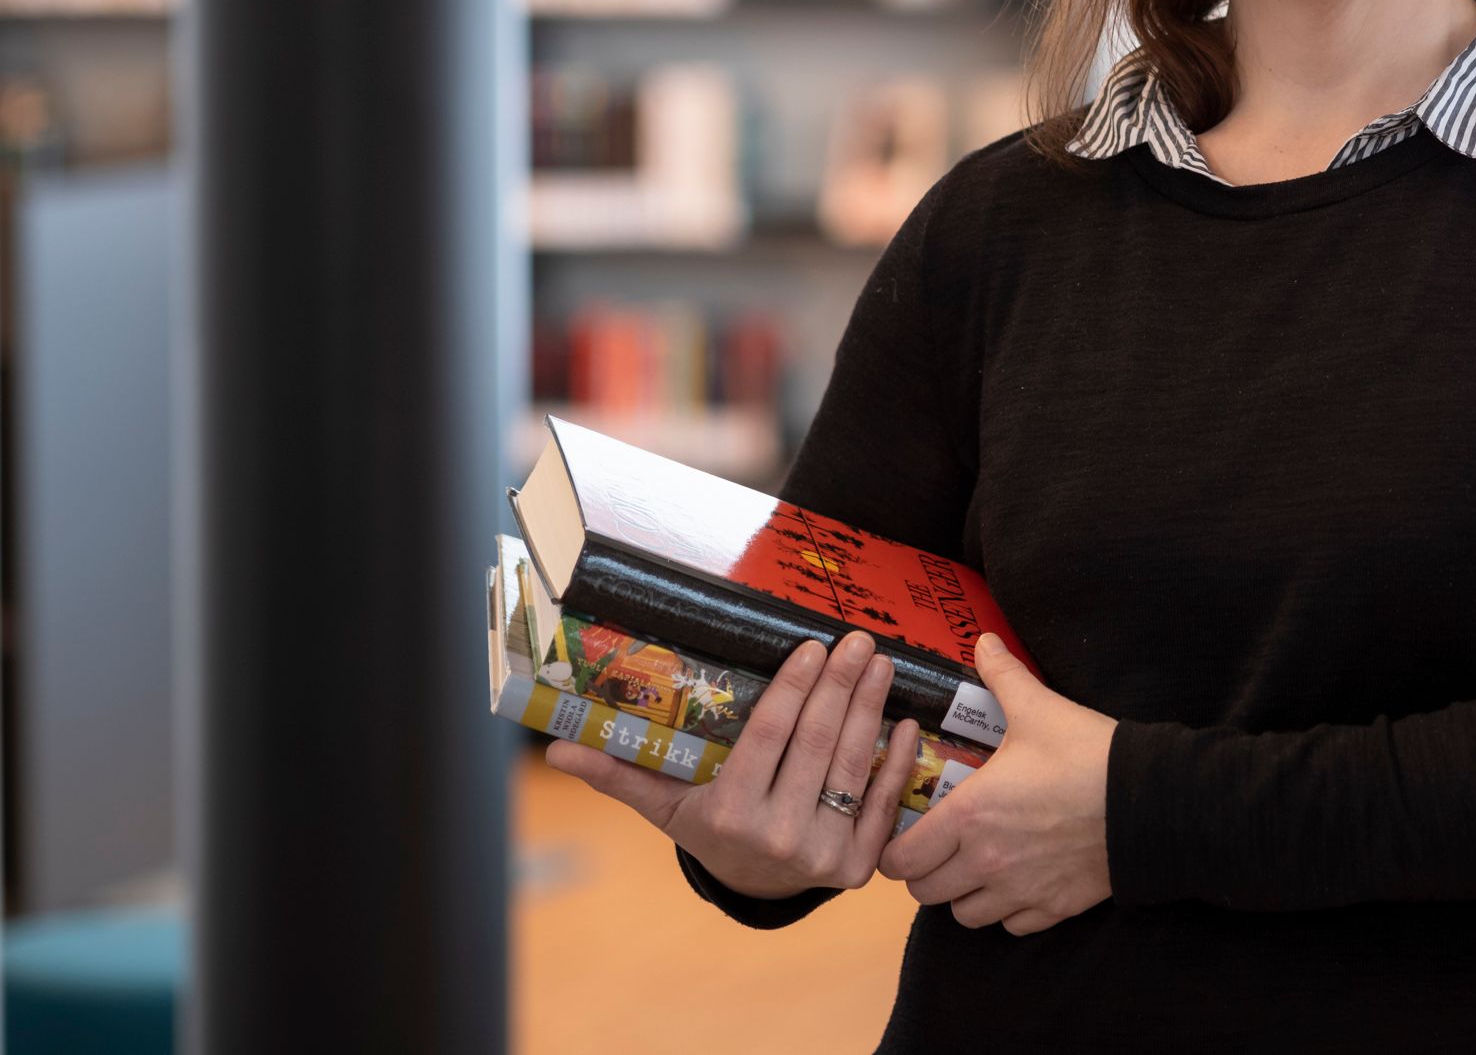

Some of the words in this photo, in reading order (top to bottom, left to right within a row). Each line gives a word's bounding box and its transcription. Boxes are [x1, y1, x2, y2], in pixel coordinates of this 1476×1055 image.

[904, 579, 938, 613] THE
[553, 699, 571, 731] KRISTIN
[562, 705, 578, 731] WIOLA
[956, 702, 988, 720] Engelsk
[600, 720, 699, 769] Strikk
